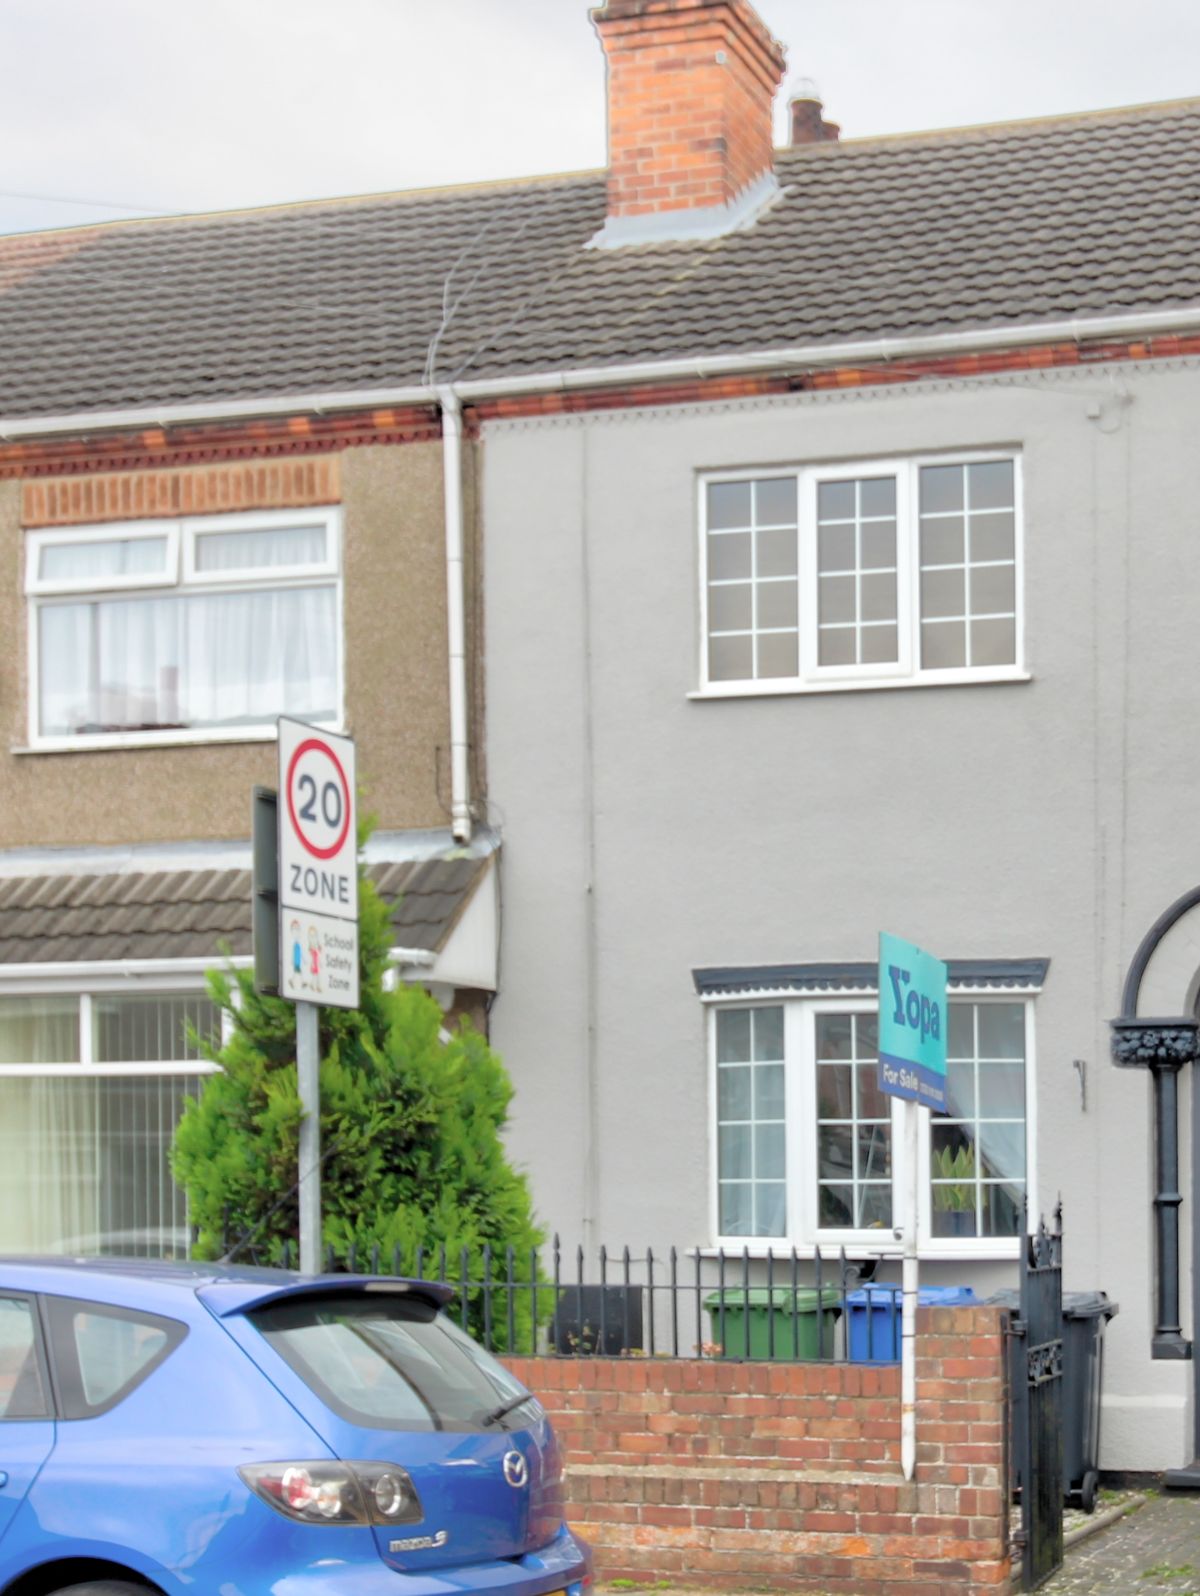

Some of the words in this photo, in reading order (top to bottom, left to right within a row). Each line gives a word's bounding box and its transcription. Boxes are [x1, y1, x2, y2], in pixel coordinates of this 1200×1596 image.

[298, 773, 342, 828] 20
[290, 864, 350, 903] ZONE
[324, 932, 354, 952] School
[325, 953, 352, 975] Safety
[328, 974, 350, 992] Zone
[888, 964, 941, 1044] Yopa
[883, 1063, 899, 1086] For
[899, 1067, 919, 1092] Sale
